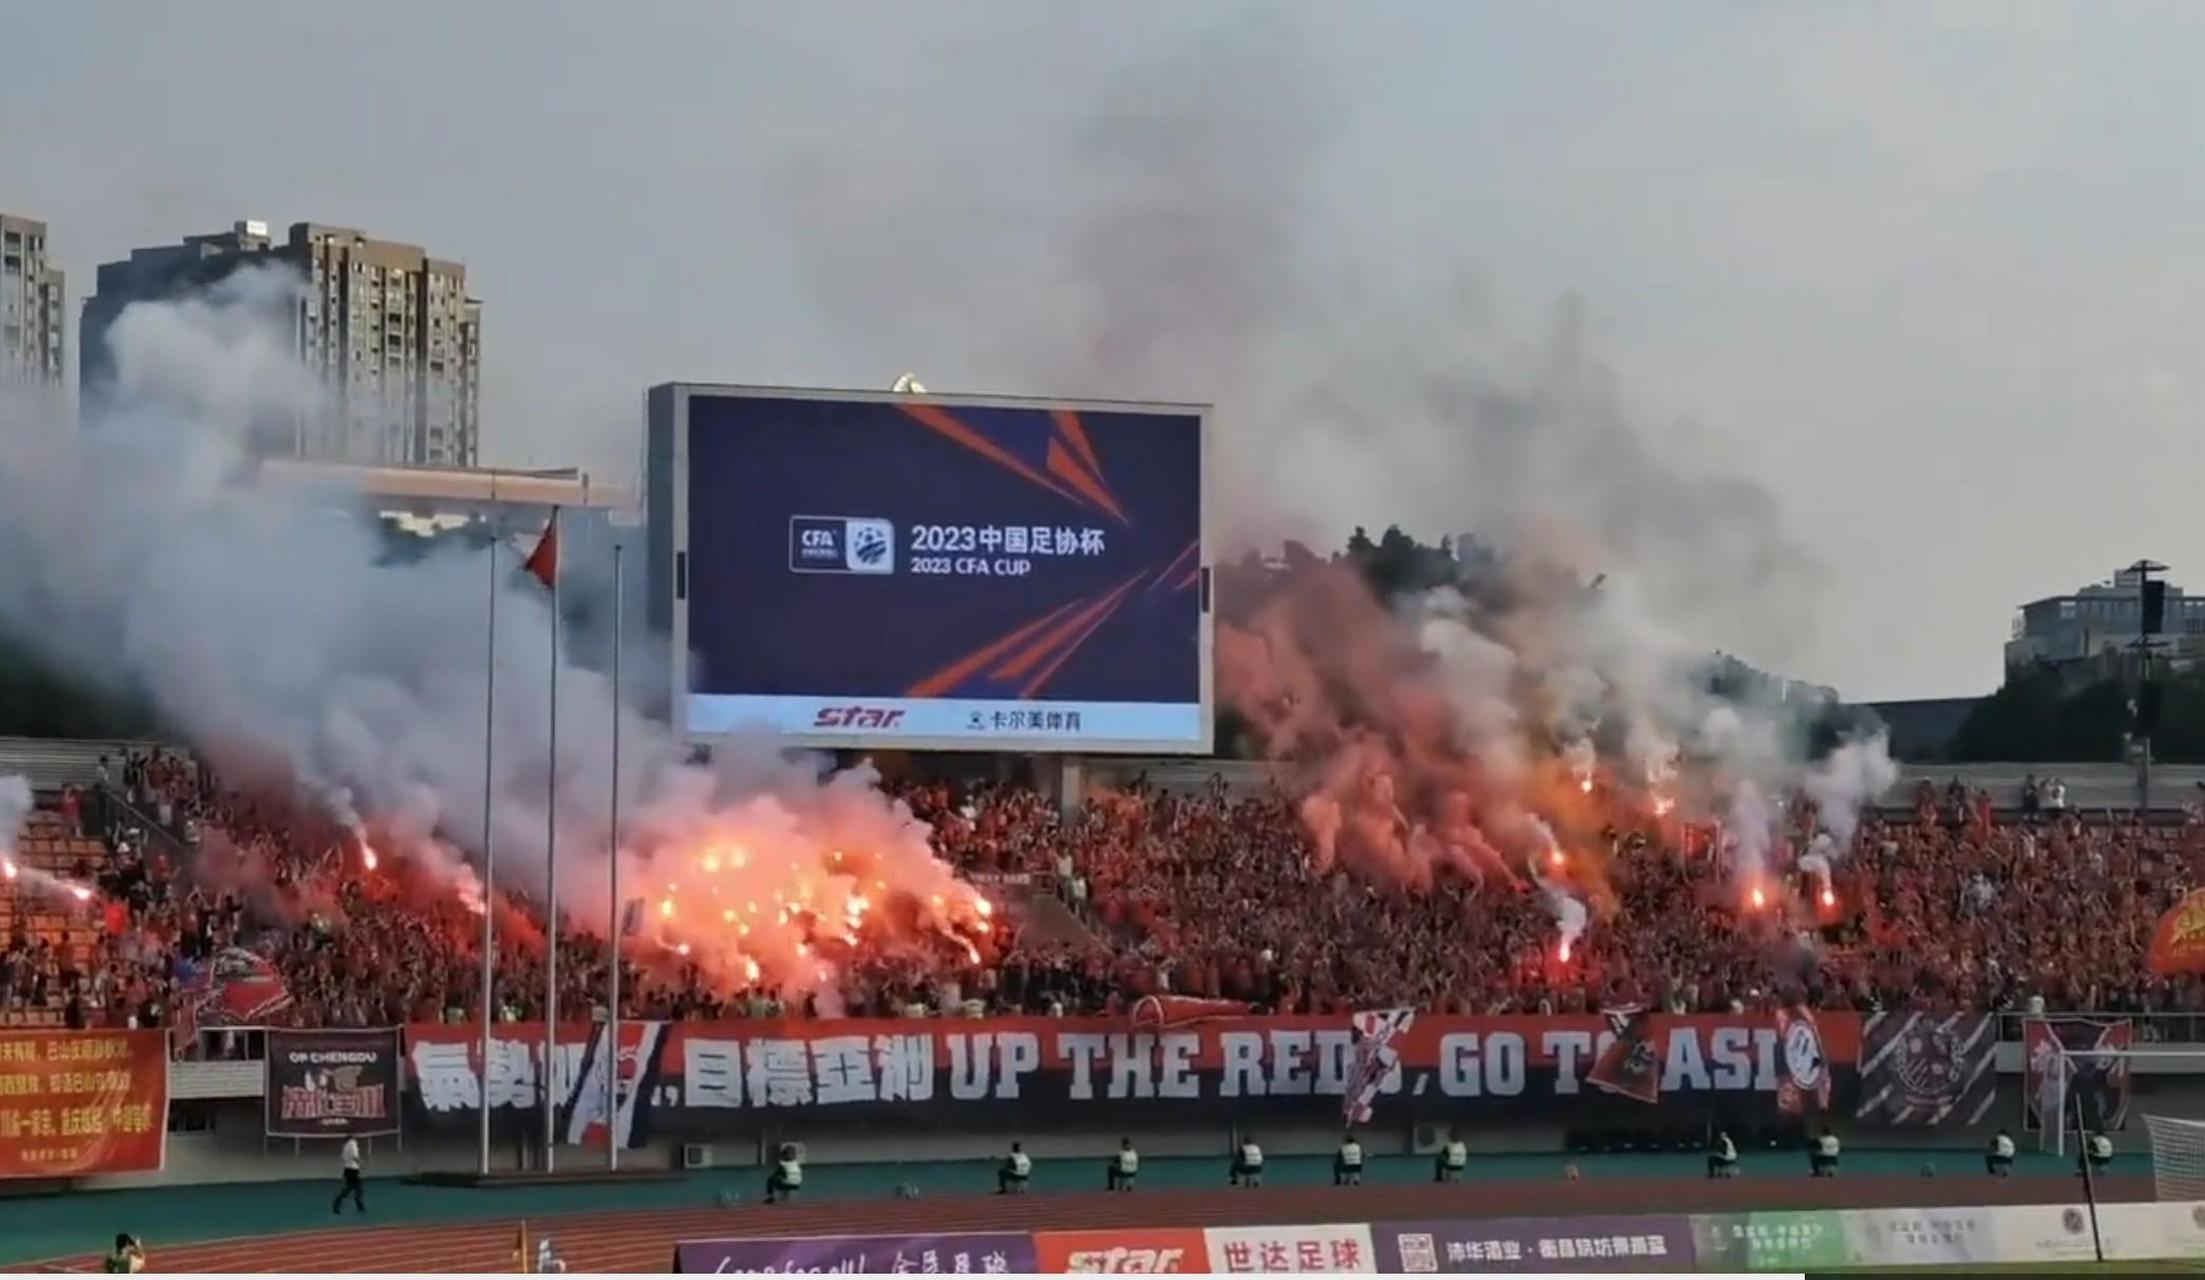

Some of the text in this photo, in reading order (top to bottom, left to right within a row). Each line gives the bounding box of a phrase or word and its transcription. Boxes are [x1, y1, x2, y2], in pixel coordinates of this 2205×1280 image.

[801, 530, 835, 546] CFA
[911, 525, 1105, 557] 2023中国足协杯
[911, 557, 1031, 577] 2023 CFA CUP
[990, 711, 1081, 732] 卡尔美体育
[310, 1051, 377, 1064] CHENGDU
[947, 1030, 1040, 1100] UP
[1059, 1030, 1199, 1100] THE
[1440, 1031, 1524, 1097] GO
[1660, 1026, 1779, 1092] ASI
[1223, 1238, 1361, 1273] 世达足球
